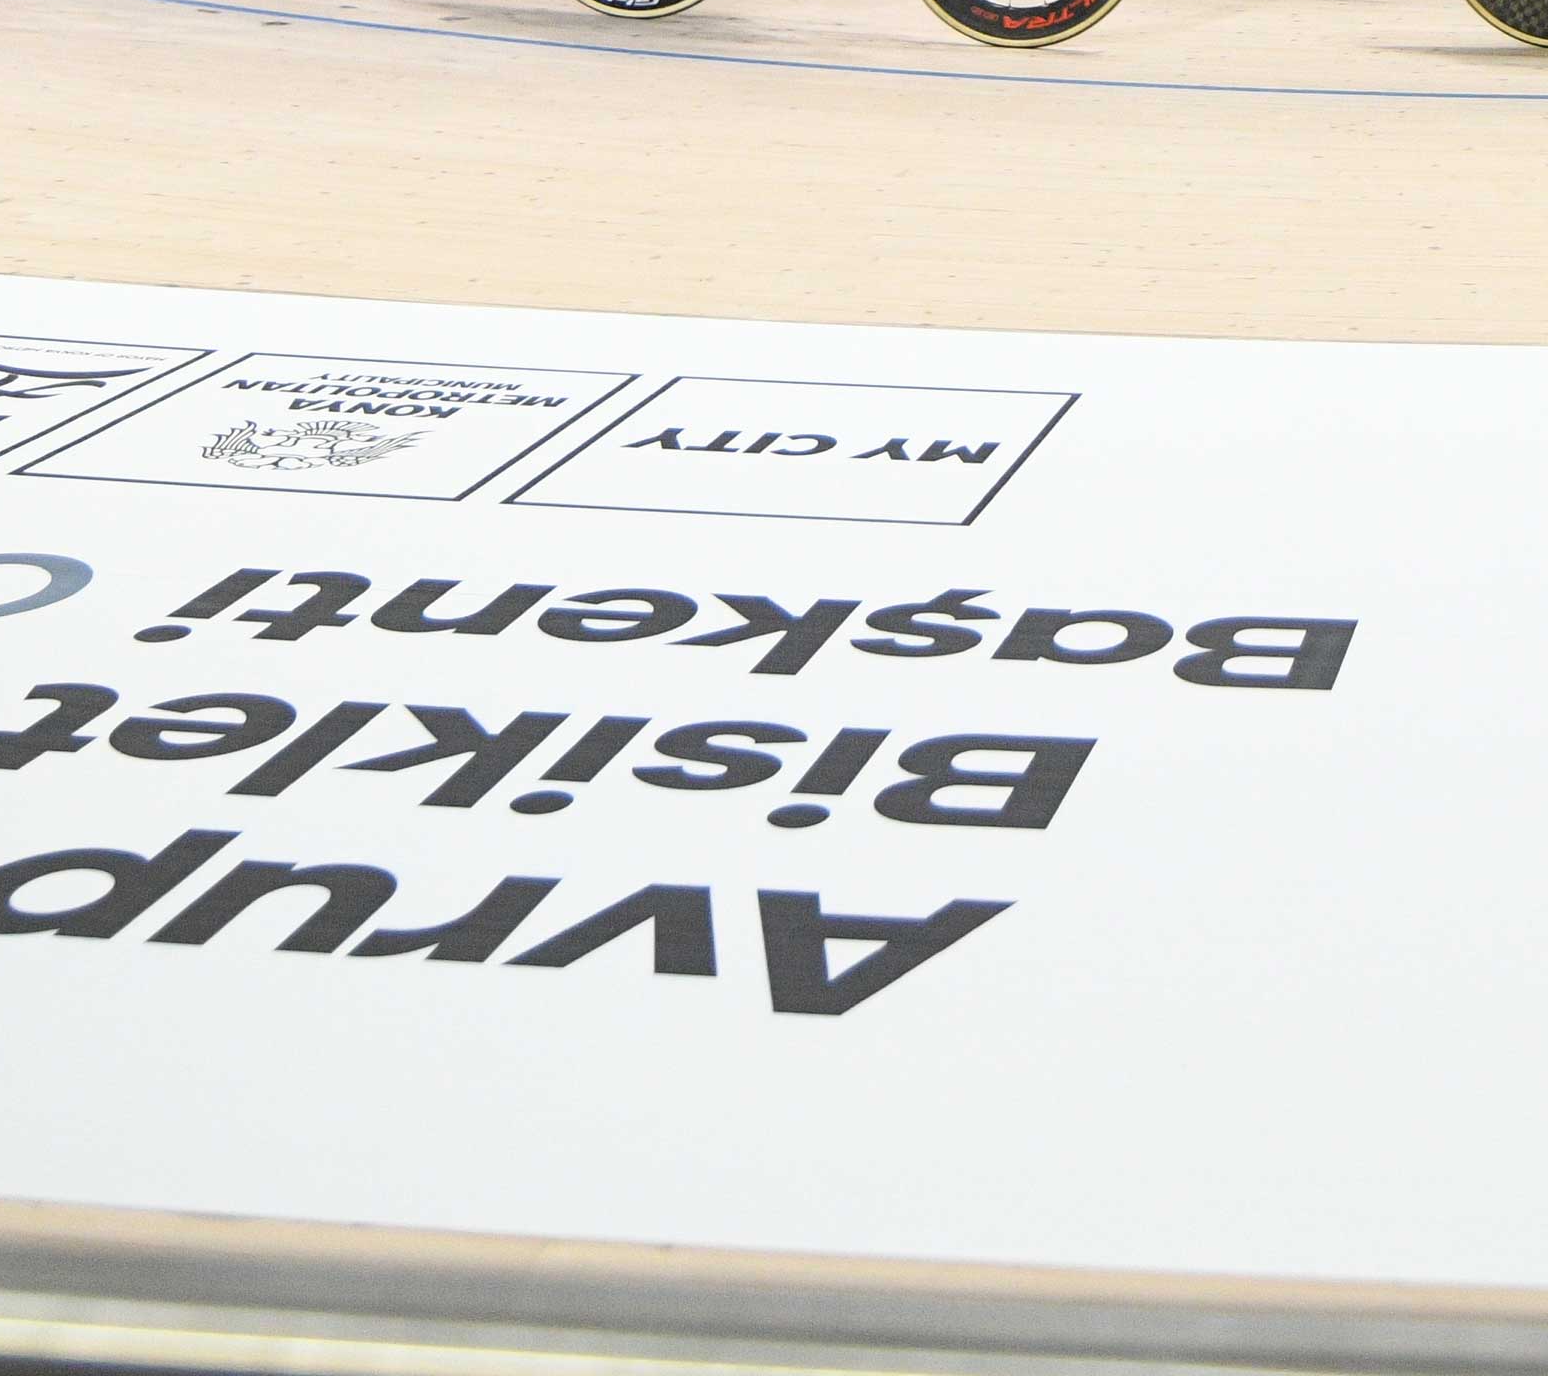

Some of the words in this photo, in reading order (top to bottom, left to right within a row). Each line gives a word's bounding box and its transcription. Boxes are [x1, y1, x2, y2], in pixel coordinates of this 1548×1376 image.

[220, 378, 569, 407] METROPOLITAN
[313, 372, 523, 391] MUNICIPALITY
[288, 398, 462, 419] KONYA
[621, 427, 838, 457] CITY
[850, 437, 1002, 465] MY
[171, 567, 1356, 690] Başkenti
